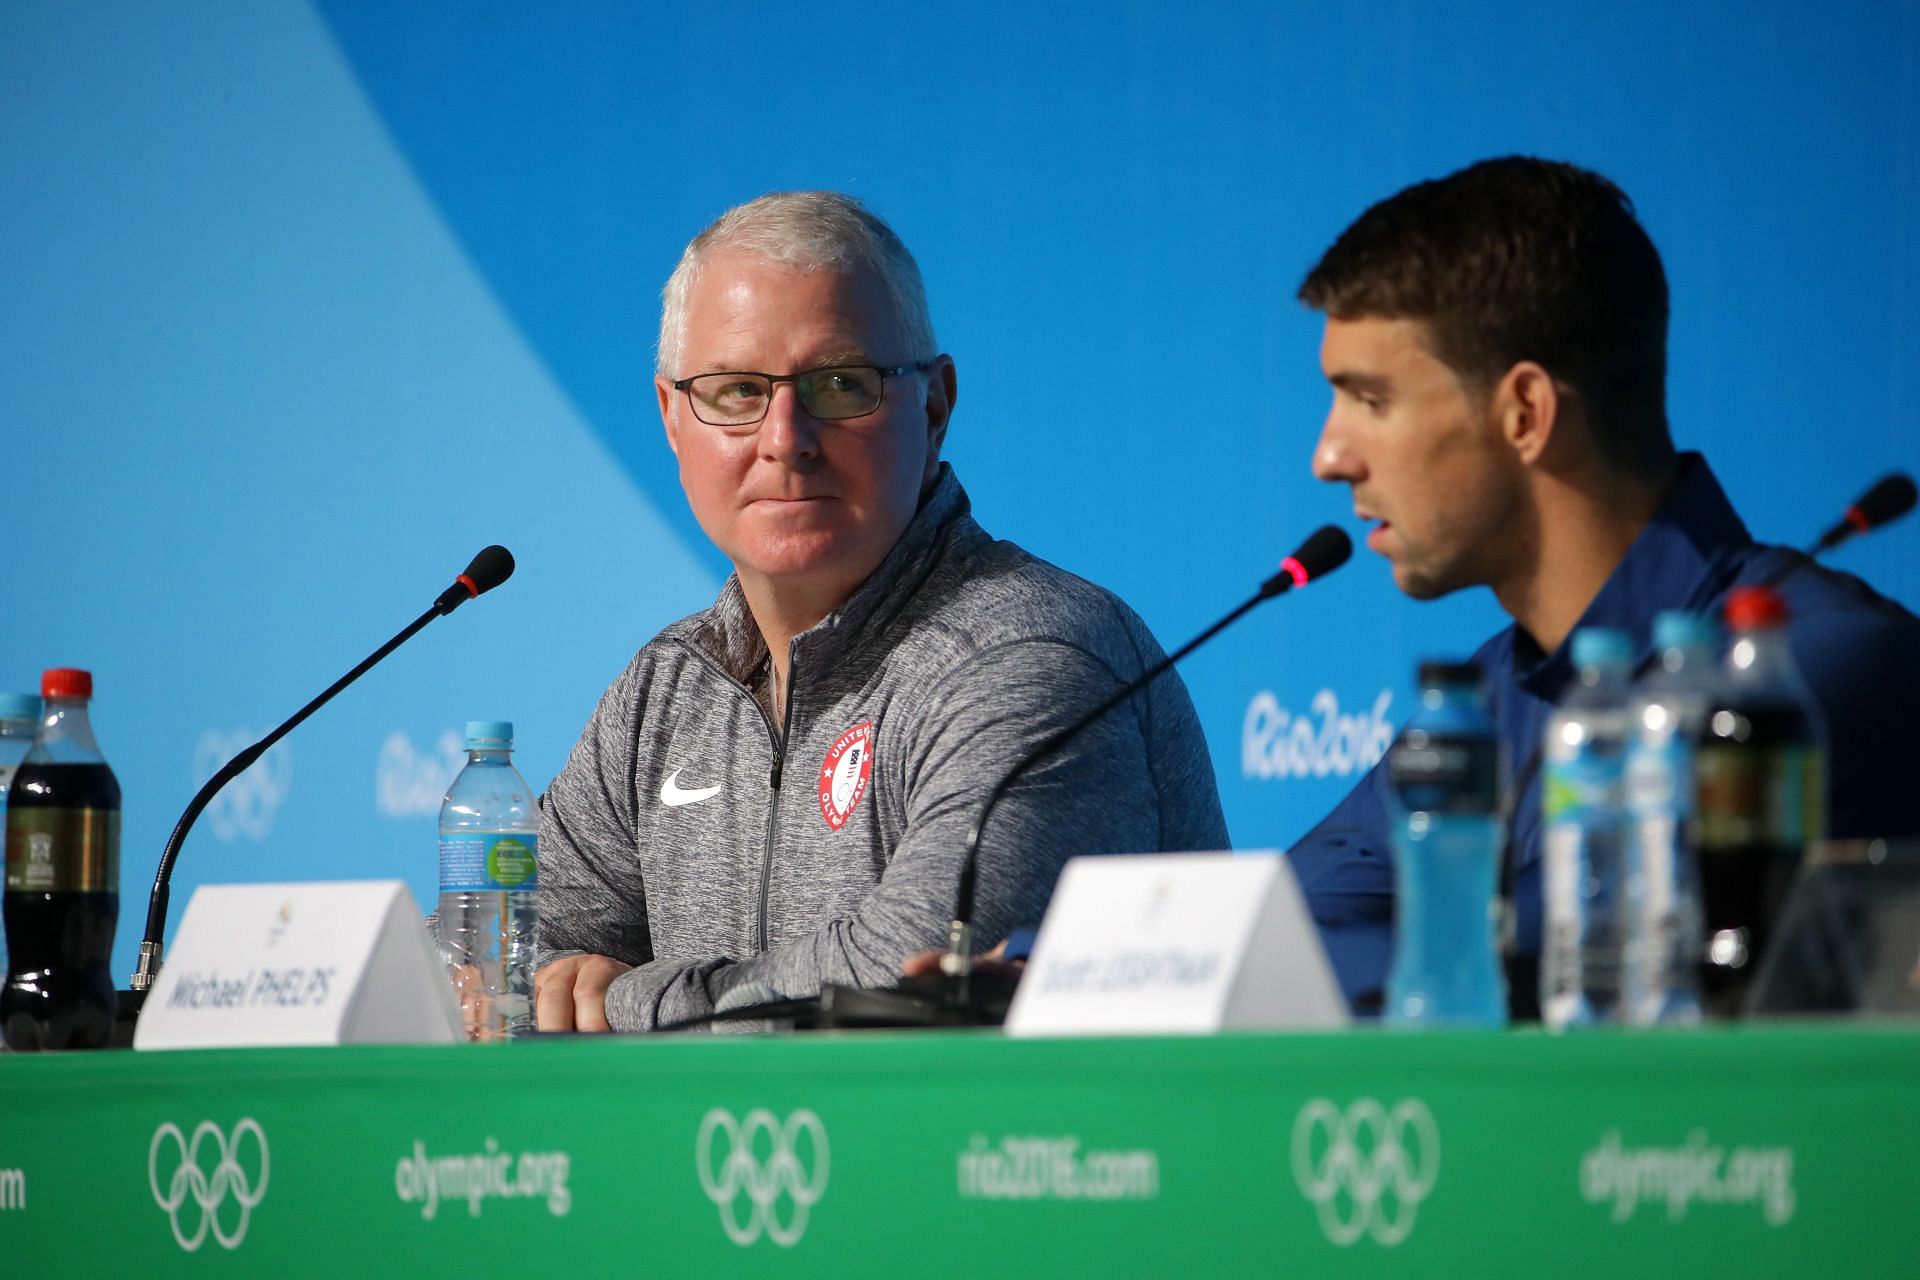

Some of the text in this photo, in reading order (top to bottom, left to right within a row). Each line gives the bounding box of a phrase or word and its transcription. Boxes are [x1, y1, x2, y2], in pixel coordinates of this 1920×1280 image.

[1241, 688, 1394, 779] Rio2016
[165, 967, 336, 1010] Michael PHELPS
[395, 1137, 572, 1220] olympic.org
[957, 1131, 1160, 1201] rio2016.com
[1579, 1127, 1796, 1226] olympic.org
